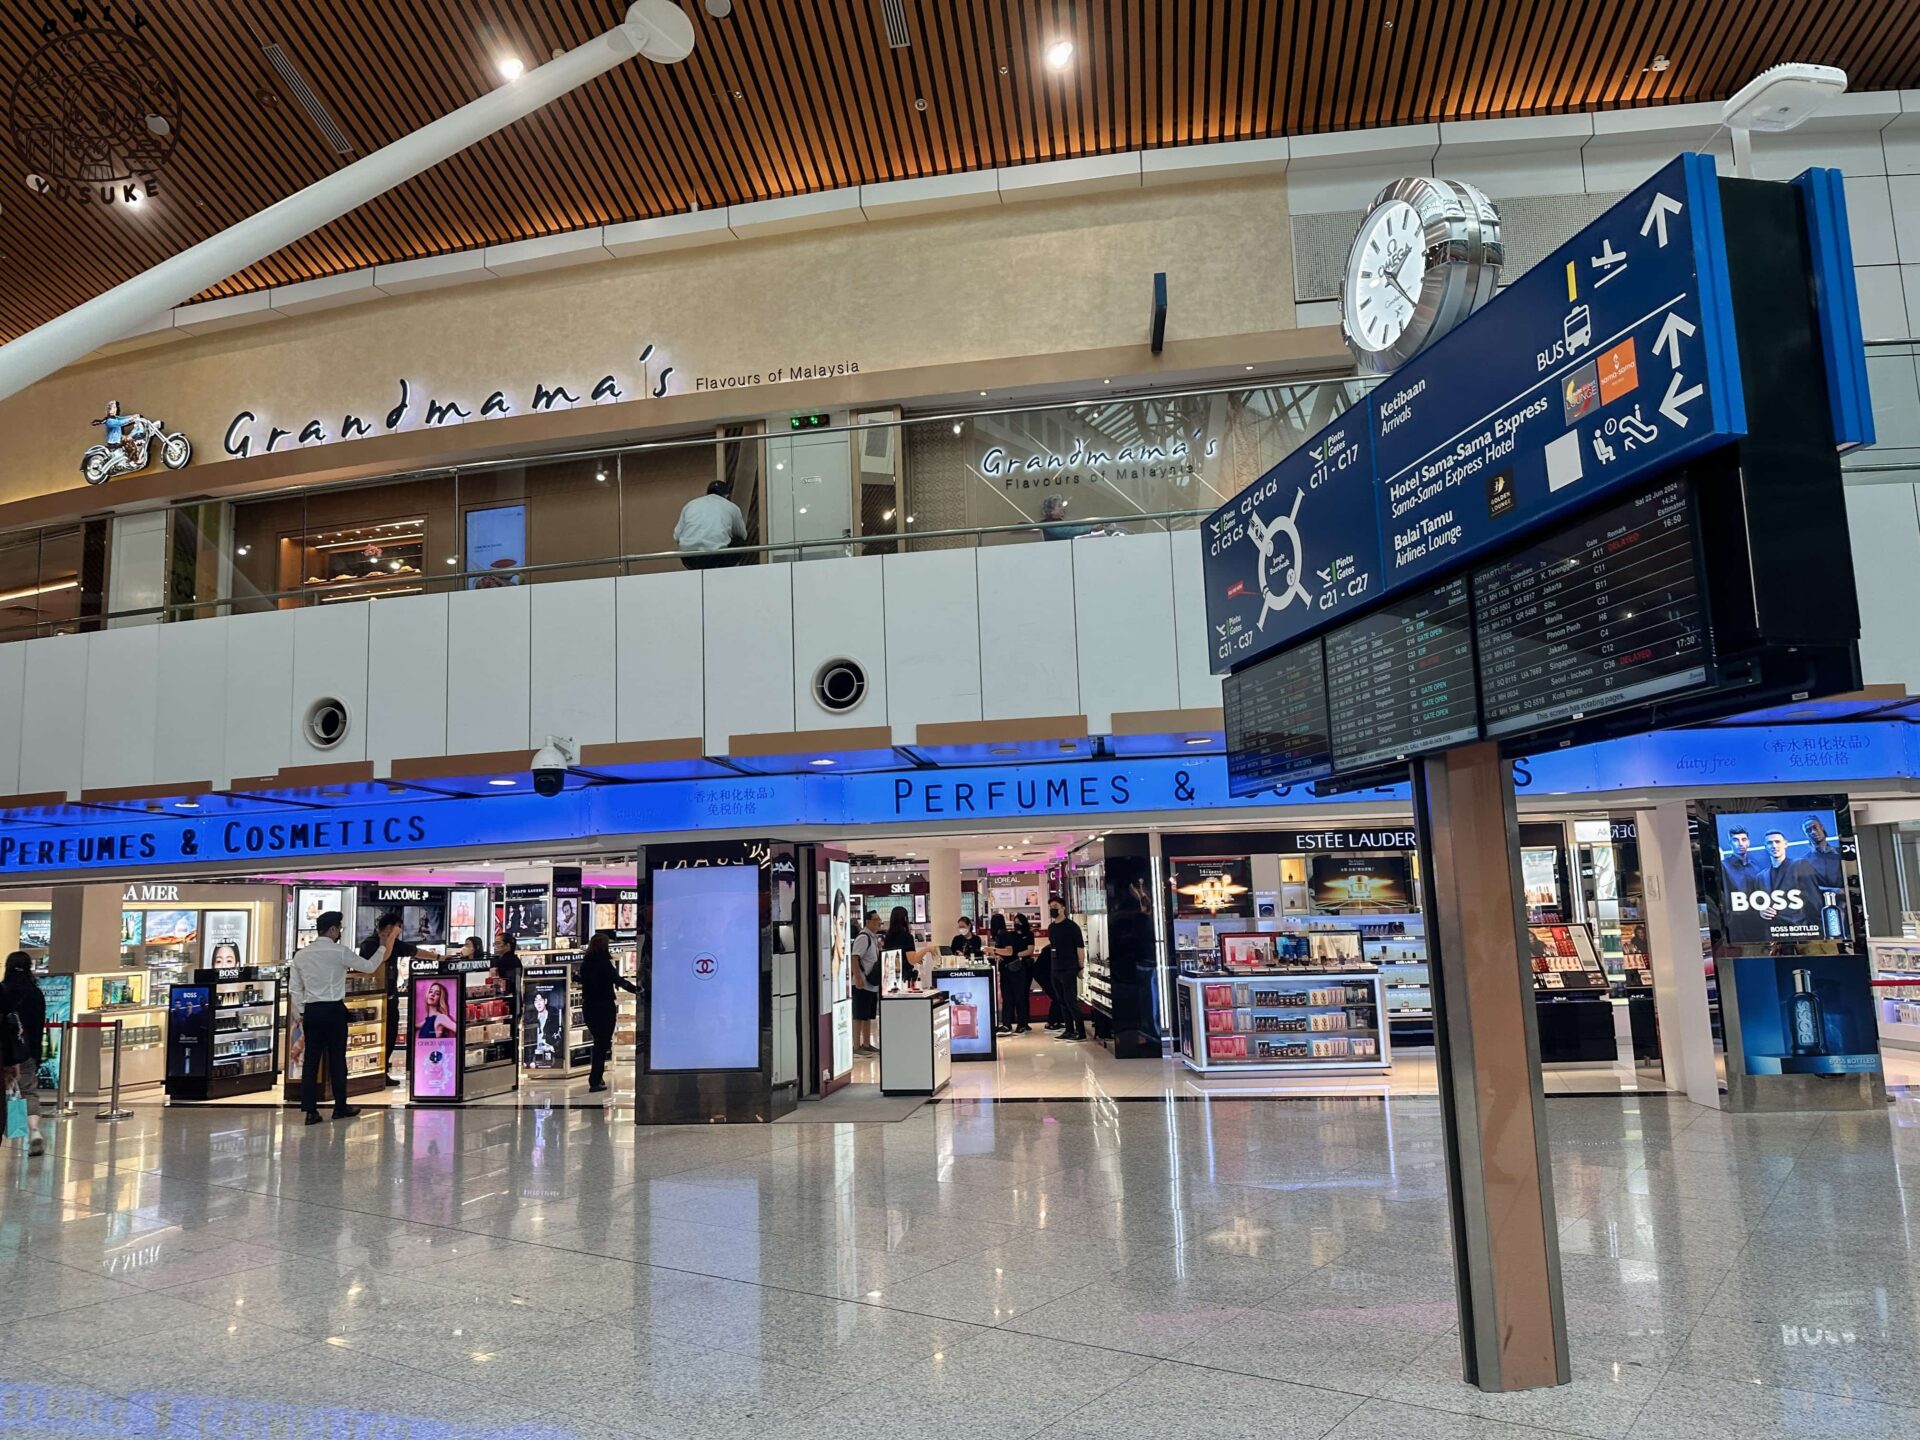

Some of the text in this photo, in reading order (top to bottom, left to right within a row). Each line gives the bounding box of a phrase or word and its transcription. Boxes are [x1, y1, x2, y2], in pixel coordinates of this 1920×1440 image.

[1536, 340, 1565, 372] BUS
[696, 360, 860, 391] Flavours of Malaysia
[224, 344, 676, 459] Grandmama's
[1380, 379, 1426, 419] Ketibaan
[1381, 405, 1412, 437] Arrivals
[1328, 429, 1345, 446] Pintu
[982, 428, 1217, 475] Grandmama's
[1328, 441, 1345, 457] Gates
[1390, 396, 1548, 502] Hotel Sama-Sama Express
[1310, 465, 1328, 489] C11
[1337, 444, 1358, 470] C17
[1392, 432, 1515, 519] Sama-Sama Express Hotel
[1005, 473, 1080, 490] Flavours
[1090, 470, 1105, 483] of
[1653, 489, 1663, 498] Jun
[1664, 482, 1678, 494] 2024
[1241, 479, 1277, 515] C2 C4 C6
[1490, 492, 1511, 505] GOLDEN
[1491, 498, 1511, 512] LOUNGE
[1657, 499, 1686, 516] Estimated
[1211, 524, 1243, 556] C1 C3 C5
[1394, 510, 1453, 551] Balai Tamu
[1592, 548, 1603, 558] A11
[1663, 514, 1682, 528] 16:50
[1395, 523, 1462, 568] Airlines Lounge
[1336, 555, 1354, 570] Pintu
[1336, 565, 1355, 580] Gates
[1593, 564, 1605, 574] C11
[1474, 562, 1511, 585] DEPARTURE
[1319, 593, 1337, 611] C21
[1347, 573, 1369, 597] C27
[1597, 595, 1608, 605] C21
[1600, 628, 1609, 638] C4
[1676, 635, 1695, 648] 17:30
[1218, 643, 1231, 659] C31
[1238, 631, 1254, 649] C37
[1601, 644, 1614, 654] C12
[1605, 677, 1614, 686] B7
[1676, 754, 1737, 774] duty free
[1789, 752, 1850, 768] 免税价格
[894, 770, 1195, 814] PERFUMES &
[707, 802, 757, 816] 免税价格
[180, 829, 200, 856] &
[224, 816, 426, 854] COSMETICS
[1349, 832, 1416, 847] LAUDER
[142, 885, 179, 900] MER
[378, 888, 421, 901] LANCÔME
[1730, 889, 1804, 912] BOSS
[1789, 924, 1819, 932] BOTTLED
[219, 969, 239, 977] BOSS
